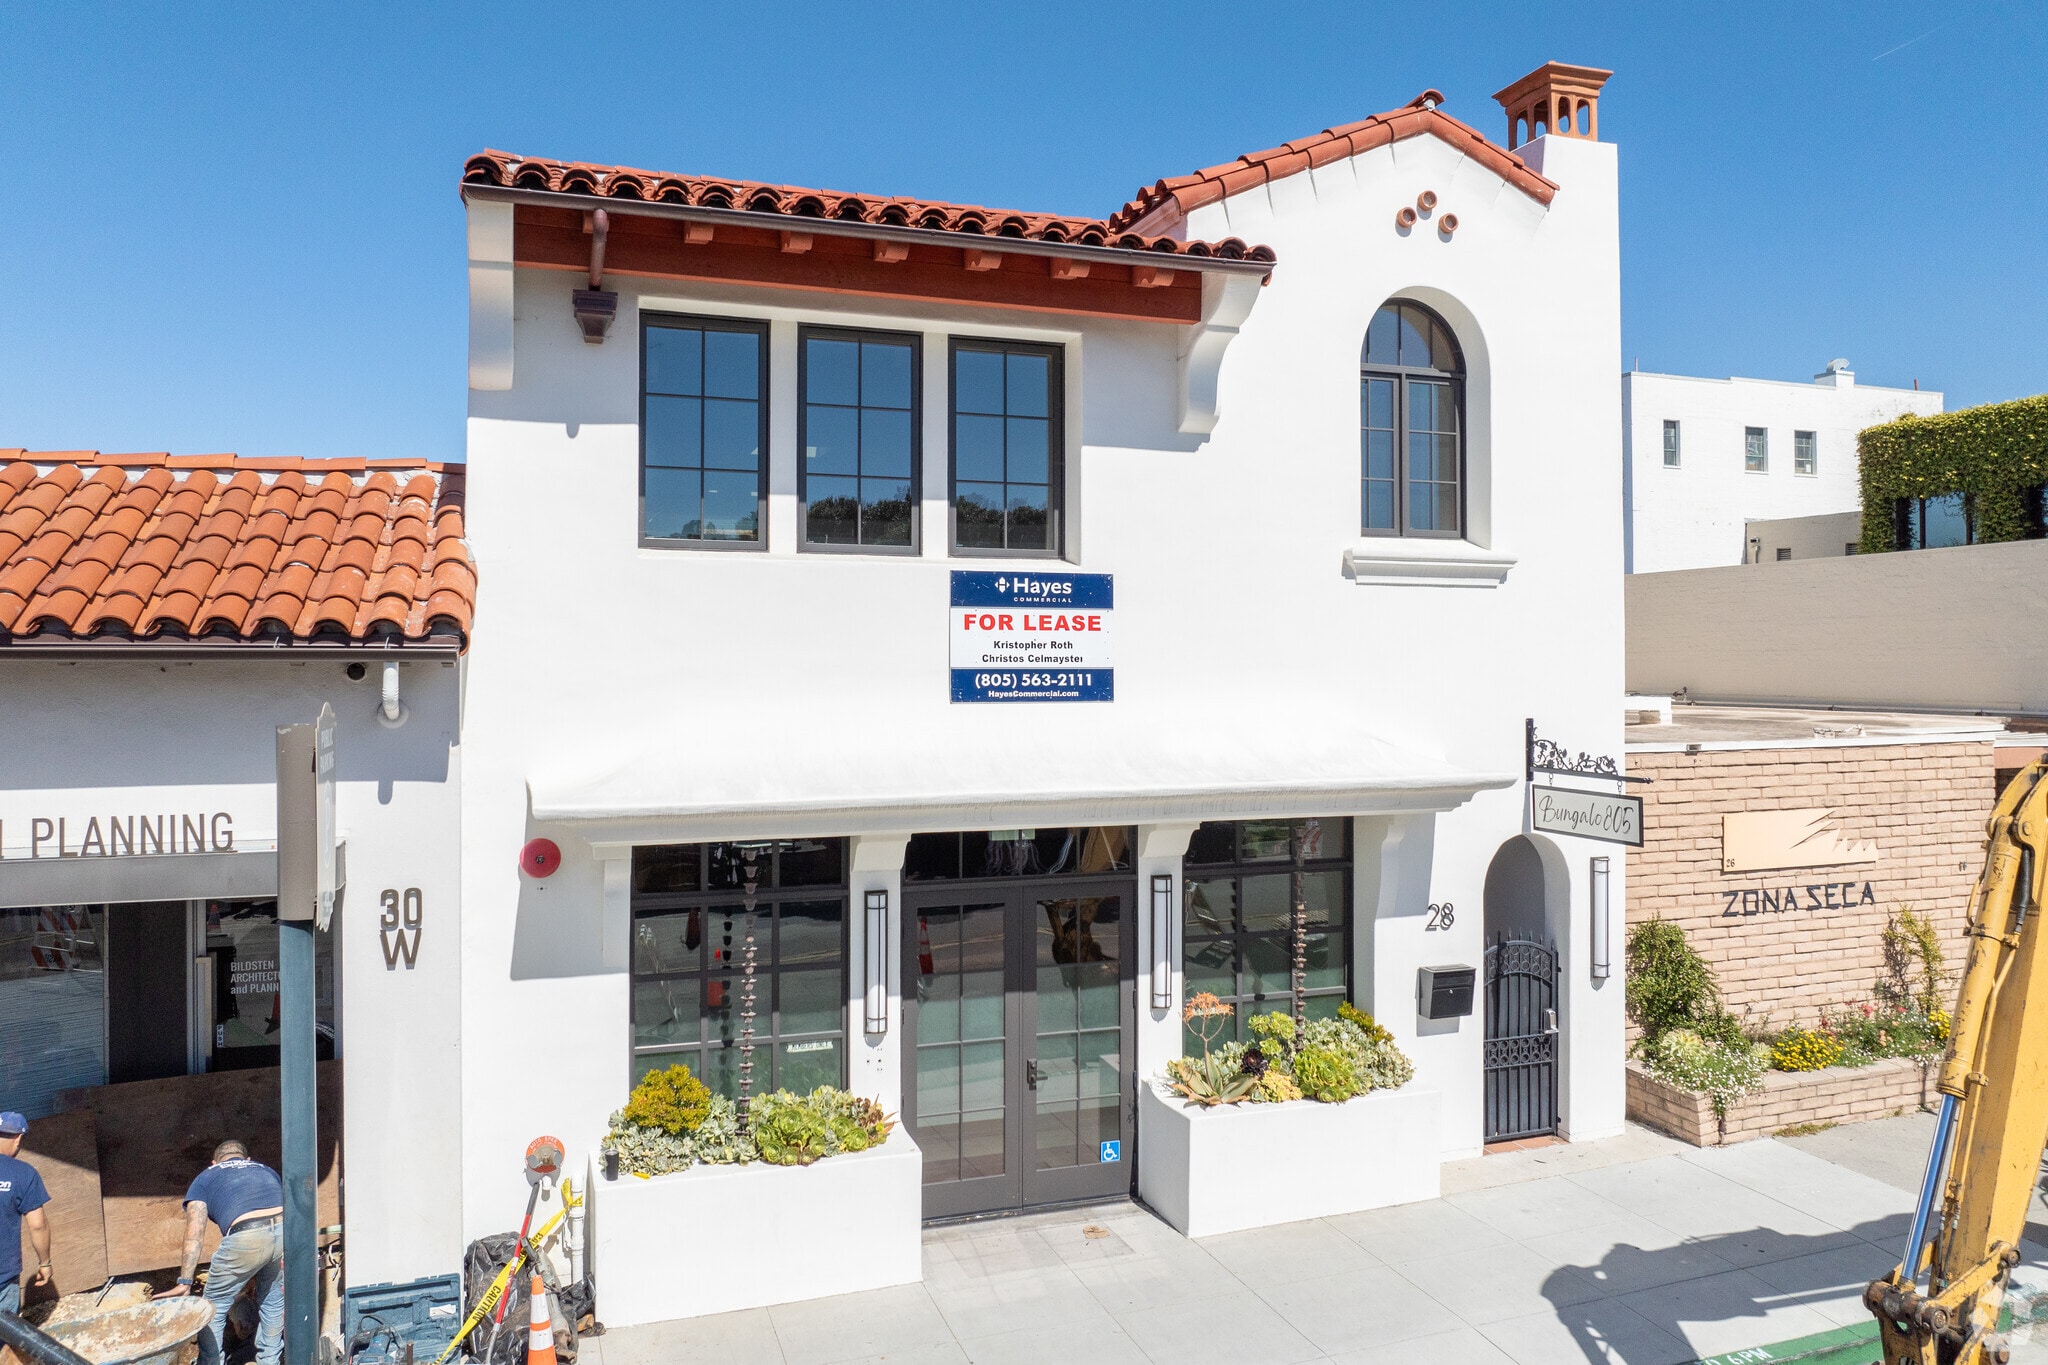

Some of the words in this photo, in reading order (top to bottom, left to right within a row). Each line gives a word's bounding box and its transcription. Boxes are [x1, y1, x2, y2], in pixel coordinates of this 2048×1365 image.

[1013, 577, 1072, 597] Hayes
[963, 613, 1014, 631] FOR
[1023, 614, 1102, 632] LEASE
[993, 640, 1047, 651] Kristopher
[1050, 640, 1073, 649] Roth
[981, 654, 1025, 663] Christos
[1027, 654, 1083, 665] Celmayster
[974, 673, 1017, 689] (805)
[1021, 673, 1092, 687] 563-2111
[988, 690, 1079, 698] HayesCommercial.com
[31, 811, 234, 859] PLANNING
[1726, 858, 1736, 868] 26
[1722, 886, 1800, 917] ZONA
[1806, 881, 1876, 911] SECA
[380, 887, 423, 930] 30
[1427, 902, 1455, 928] 28
[379, 927, 423, 967] W
[230, 960, 274, 972] BILDSTEN
[230, 984, 248, 994] and
[250, 983, 280, 993] PLANN
[472, 1285, 502, 1322] CAUTION
[1726, 1347, 1773, 1365] 6PM
